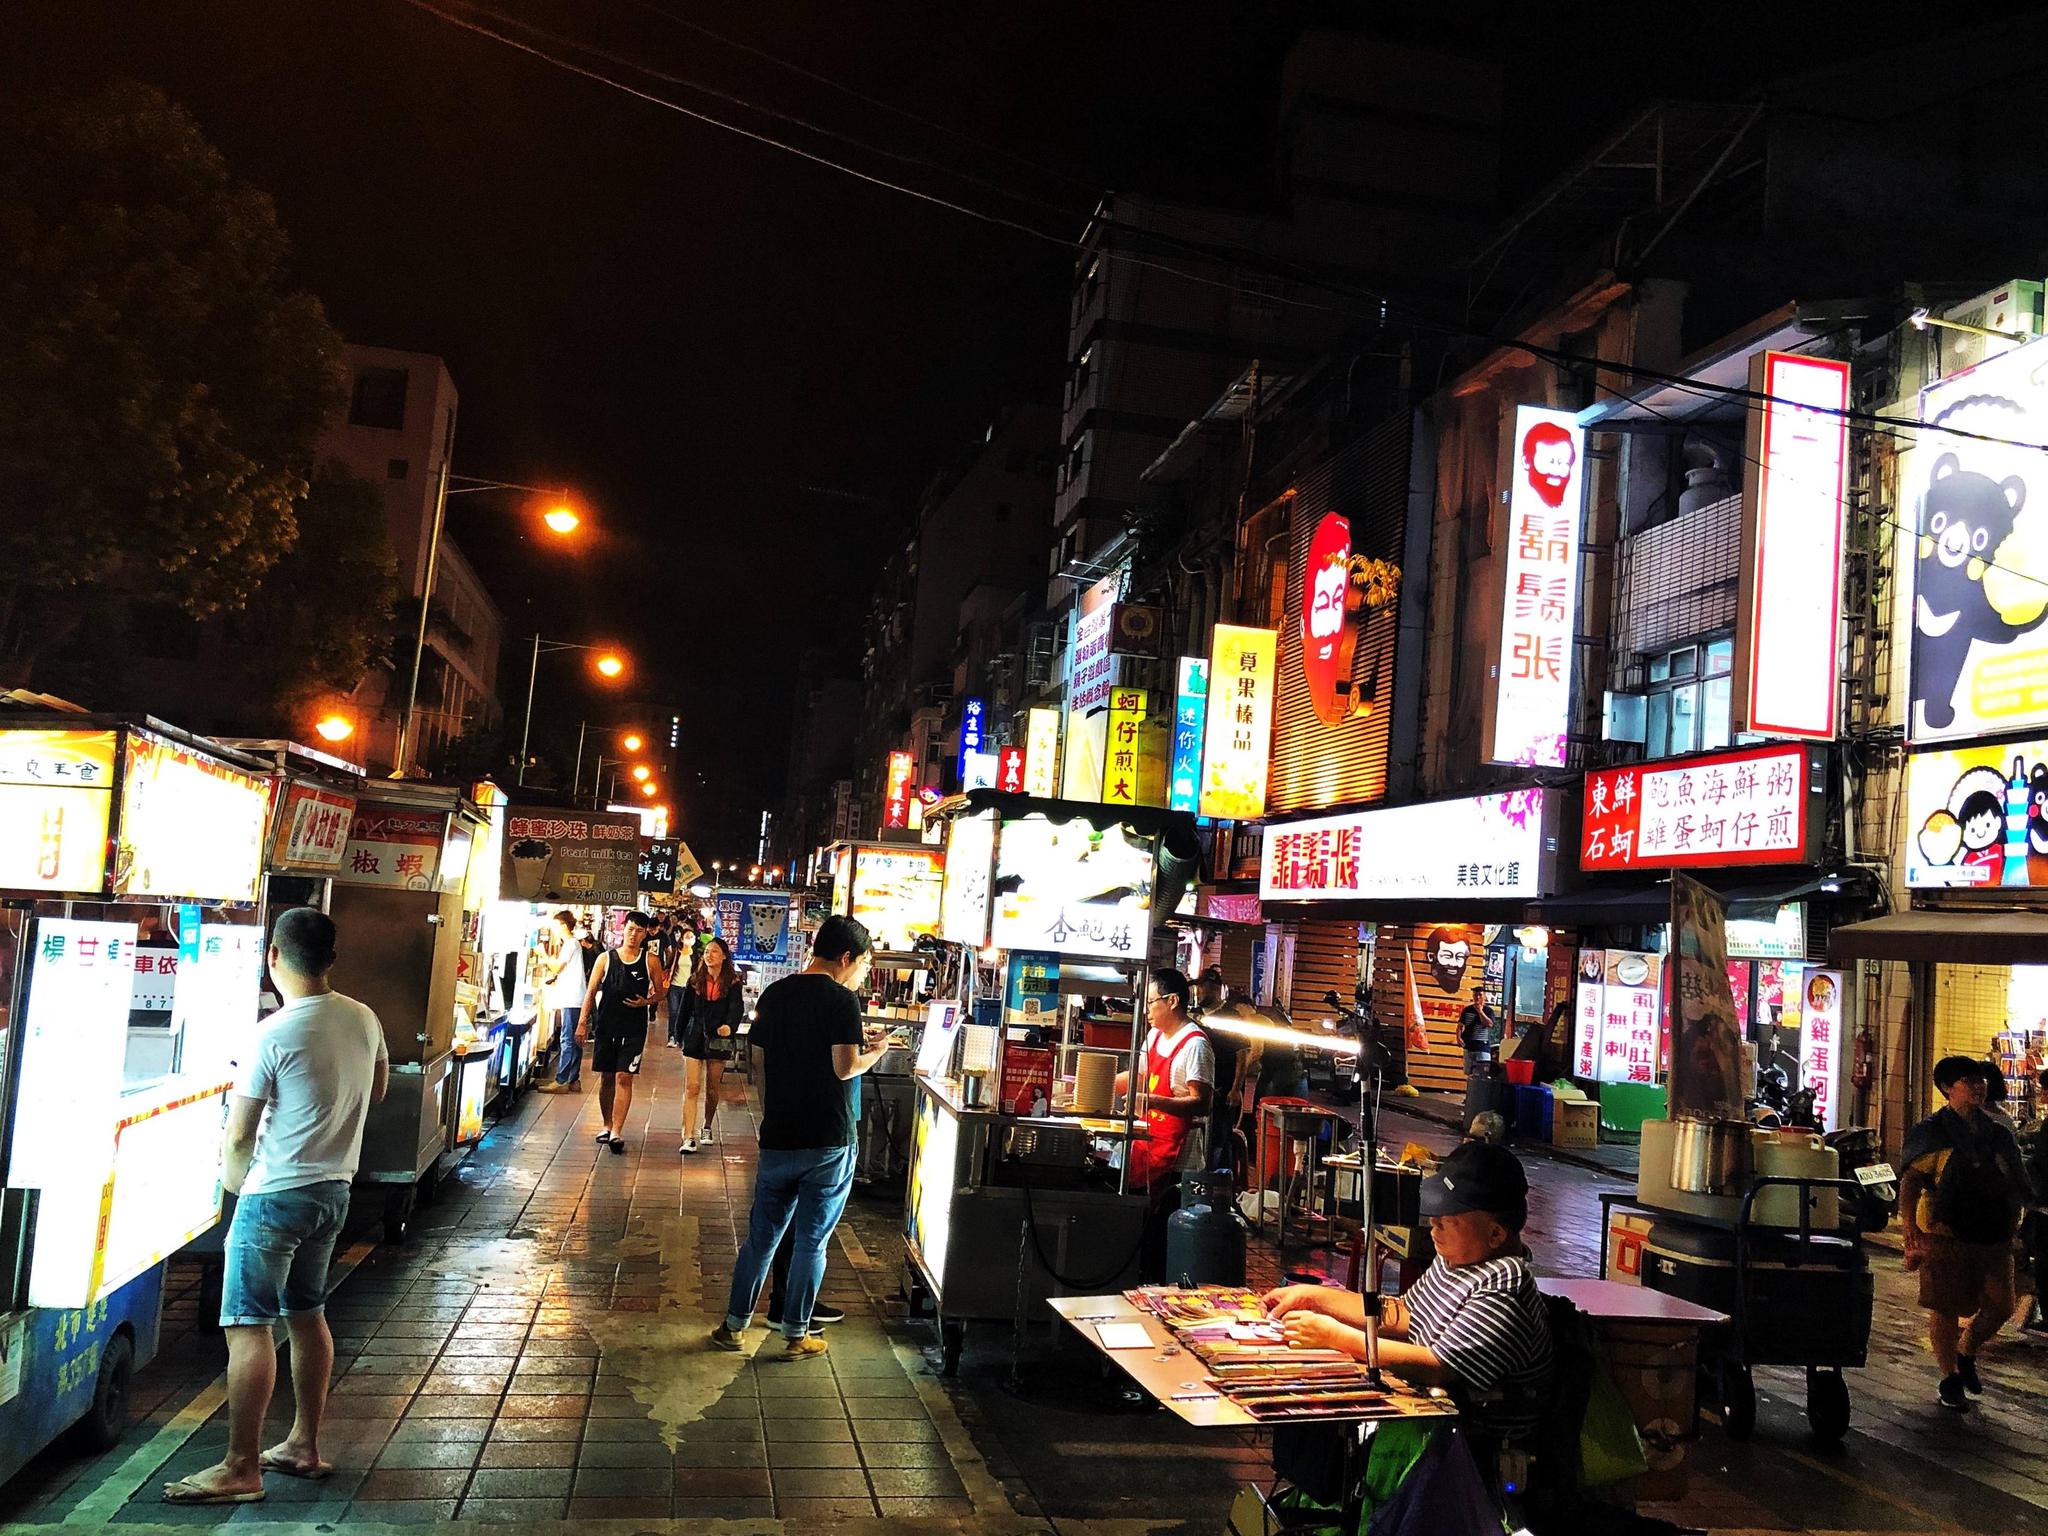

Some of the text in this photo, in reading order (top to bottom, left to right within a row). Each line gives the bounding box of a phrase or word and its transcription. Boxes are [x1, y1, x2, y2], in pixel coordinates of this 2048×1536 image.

[1511, 513, 1570, 683] 鬍鬚張
[1648, 762, 1793, 808] 鮑魚海鮮粥
[509, 817, 634, 840] 蜂蜜珍珠 鮮奶茶
[1643, 805, 1794, 851] 雞蛋蚵仔煎
[560, 846, 633, 860] Pearl milk tea
[1456, 861, 1520, 888] 美食文化館
[1604, 1013, 1628, 1058] 無刺
